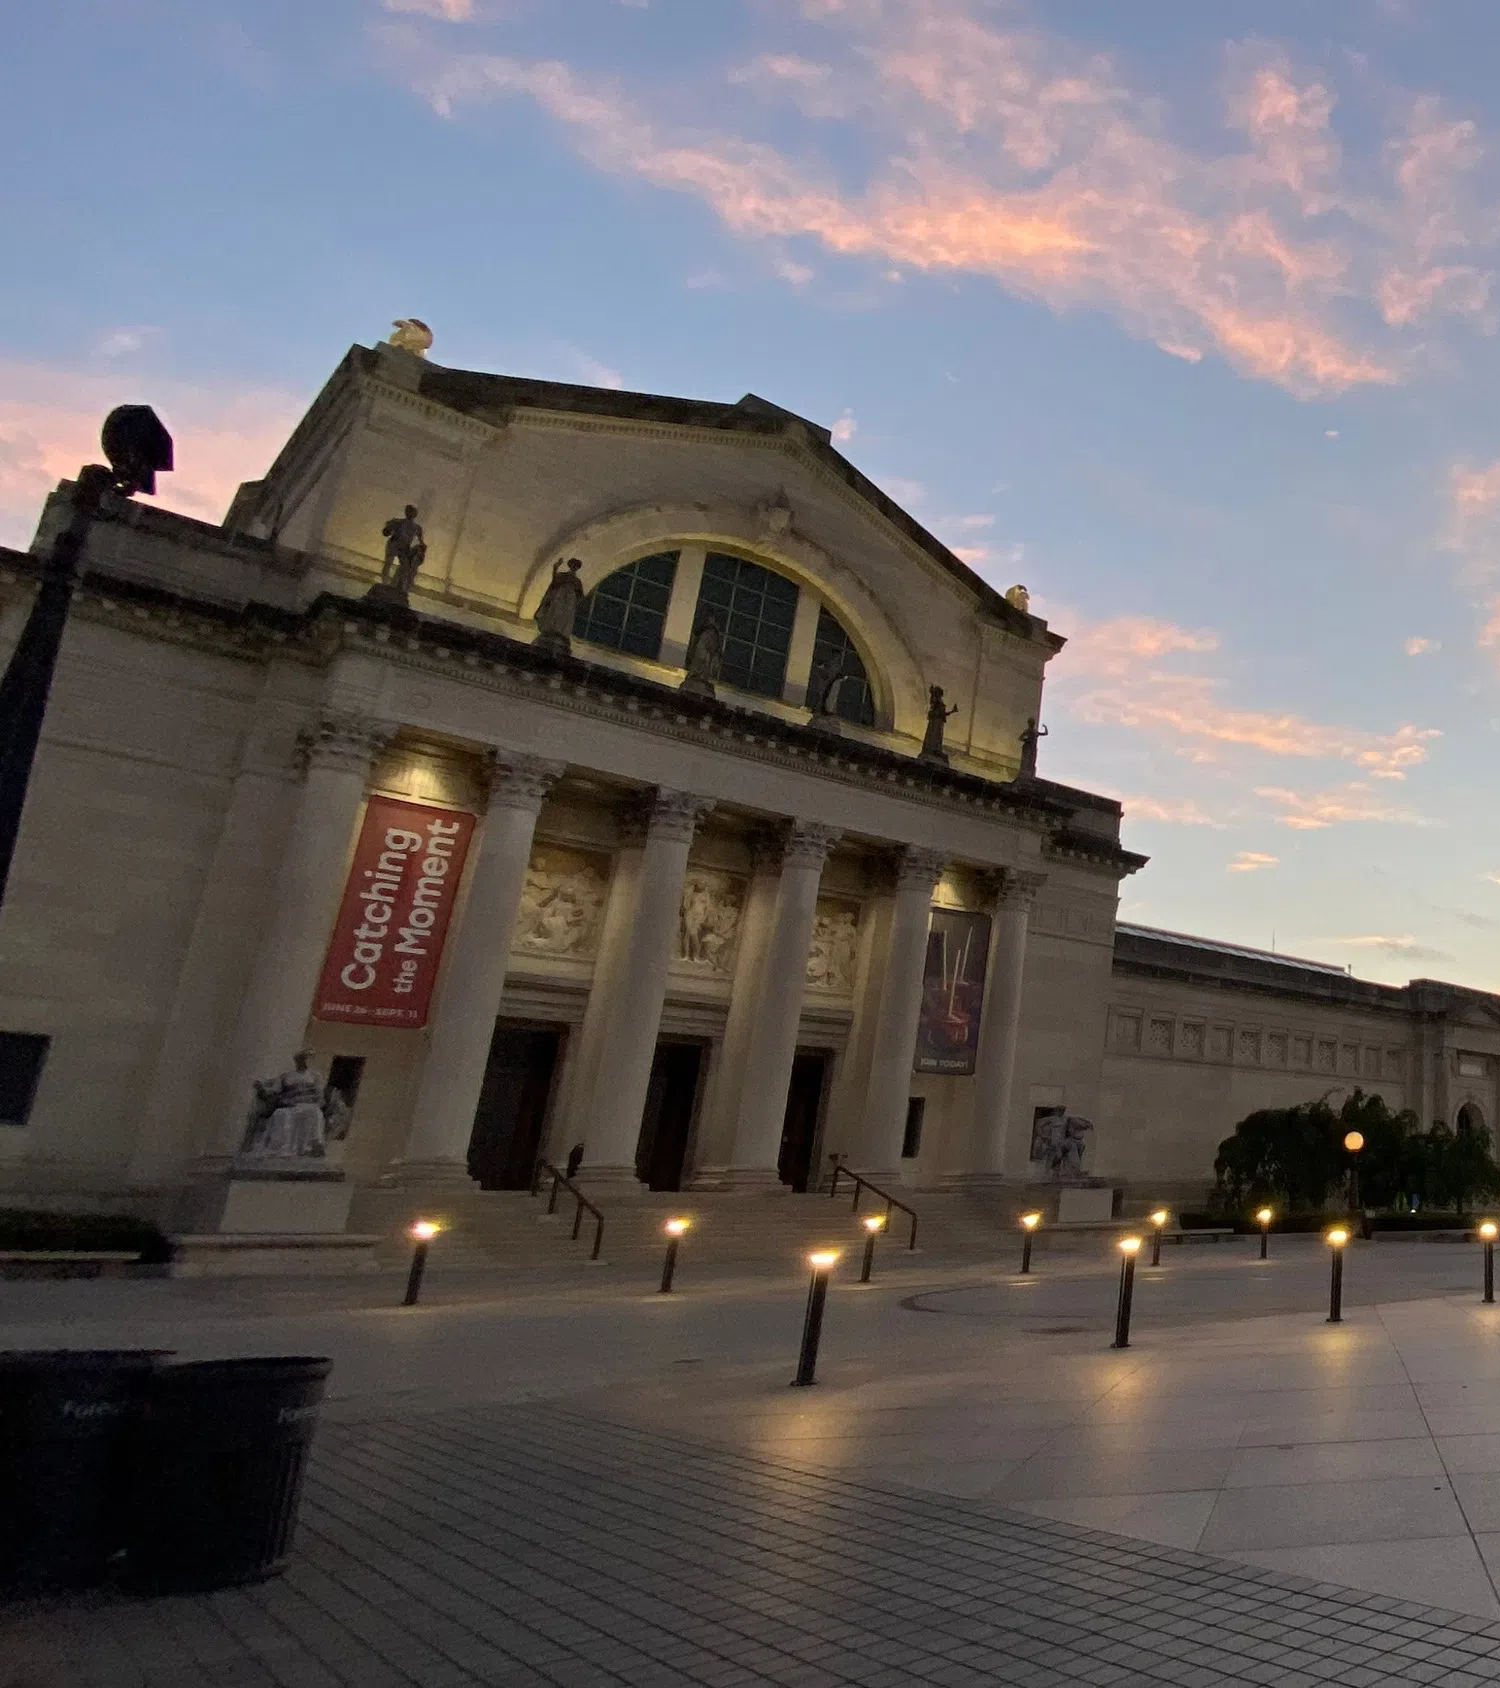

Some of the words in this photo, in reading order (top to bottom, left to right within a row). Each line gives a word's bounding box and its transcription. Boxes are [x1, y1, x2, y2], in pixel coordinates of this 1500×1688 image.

[394, 819, 460, 955] Moment
[341, 828, 423, 990] Catching
[393, 959, 418, 994] the
[322, 1002, 352, 1013] JUNE
[920, 1057, 938, 1067] JOIN
